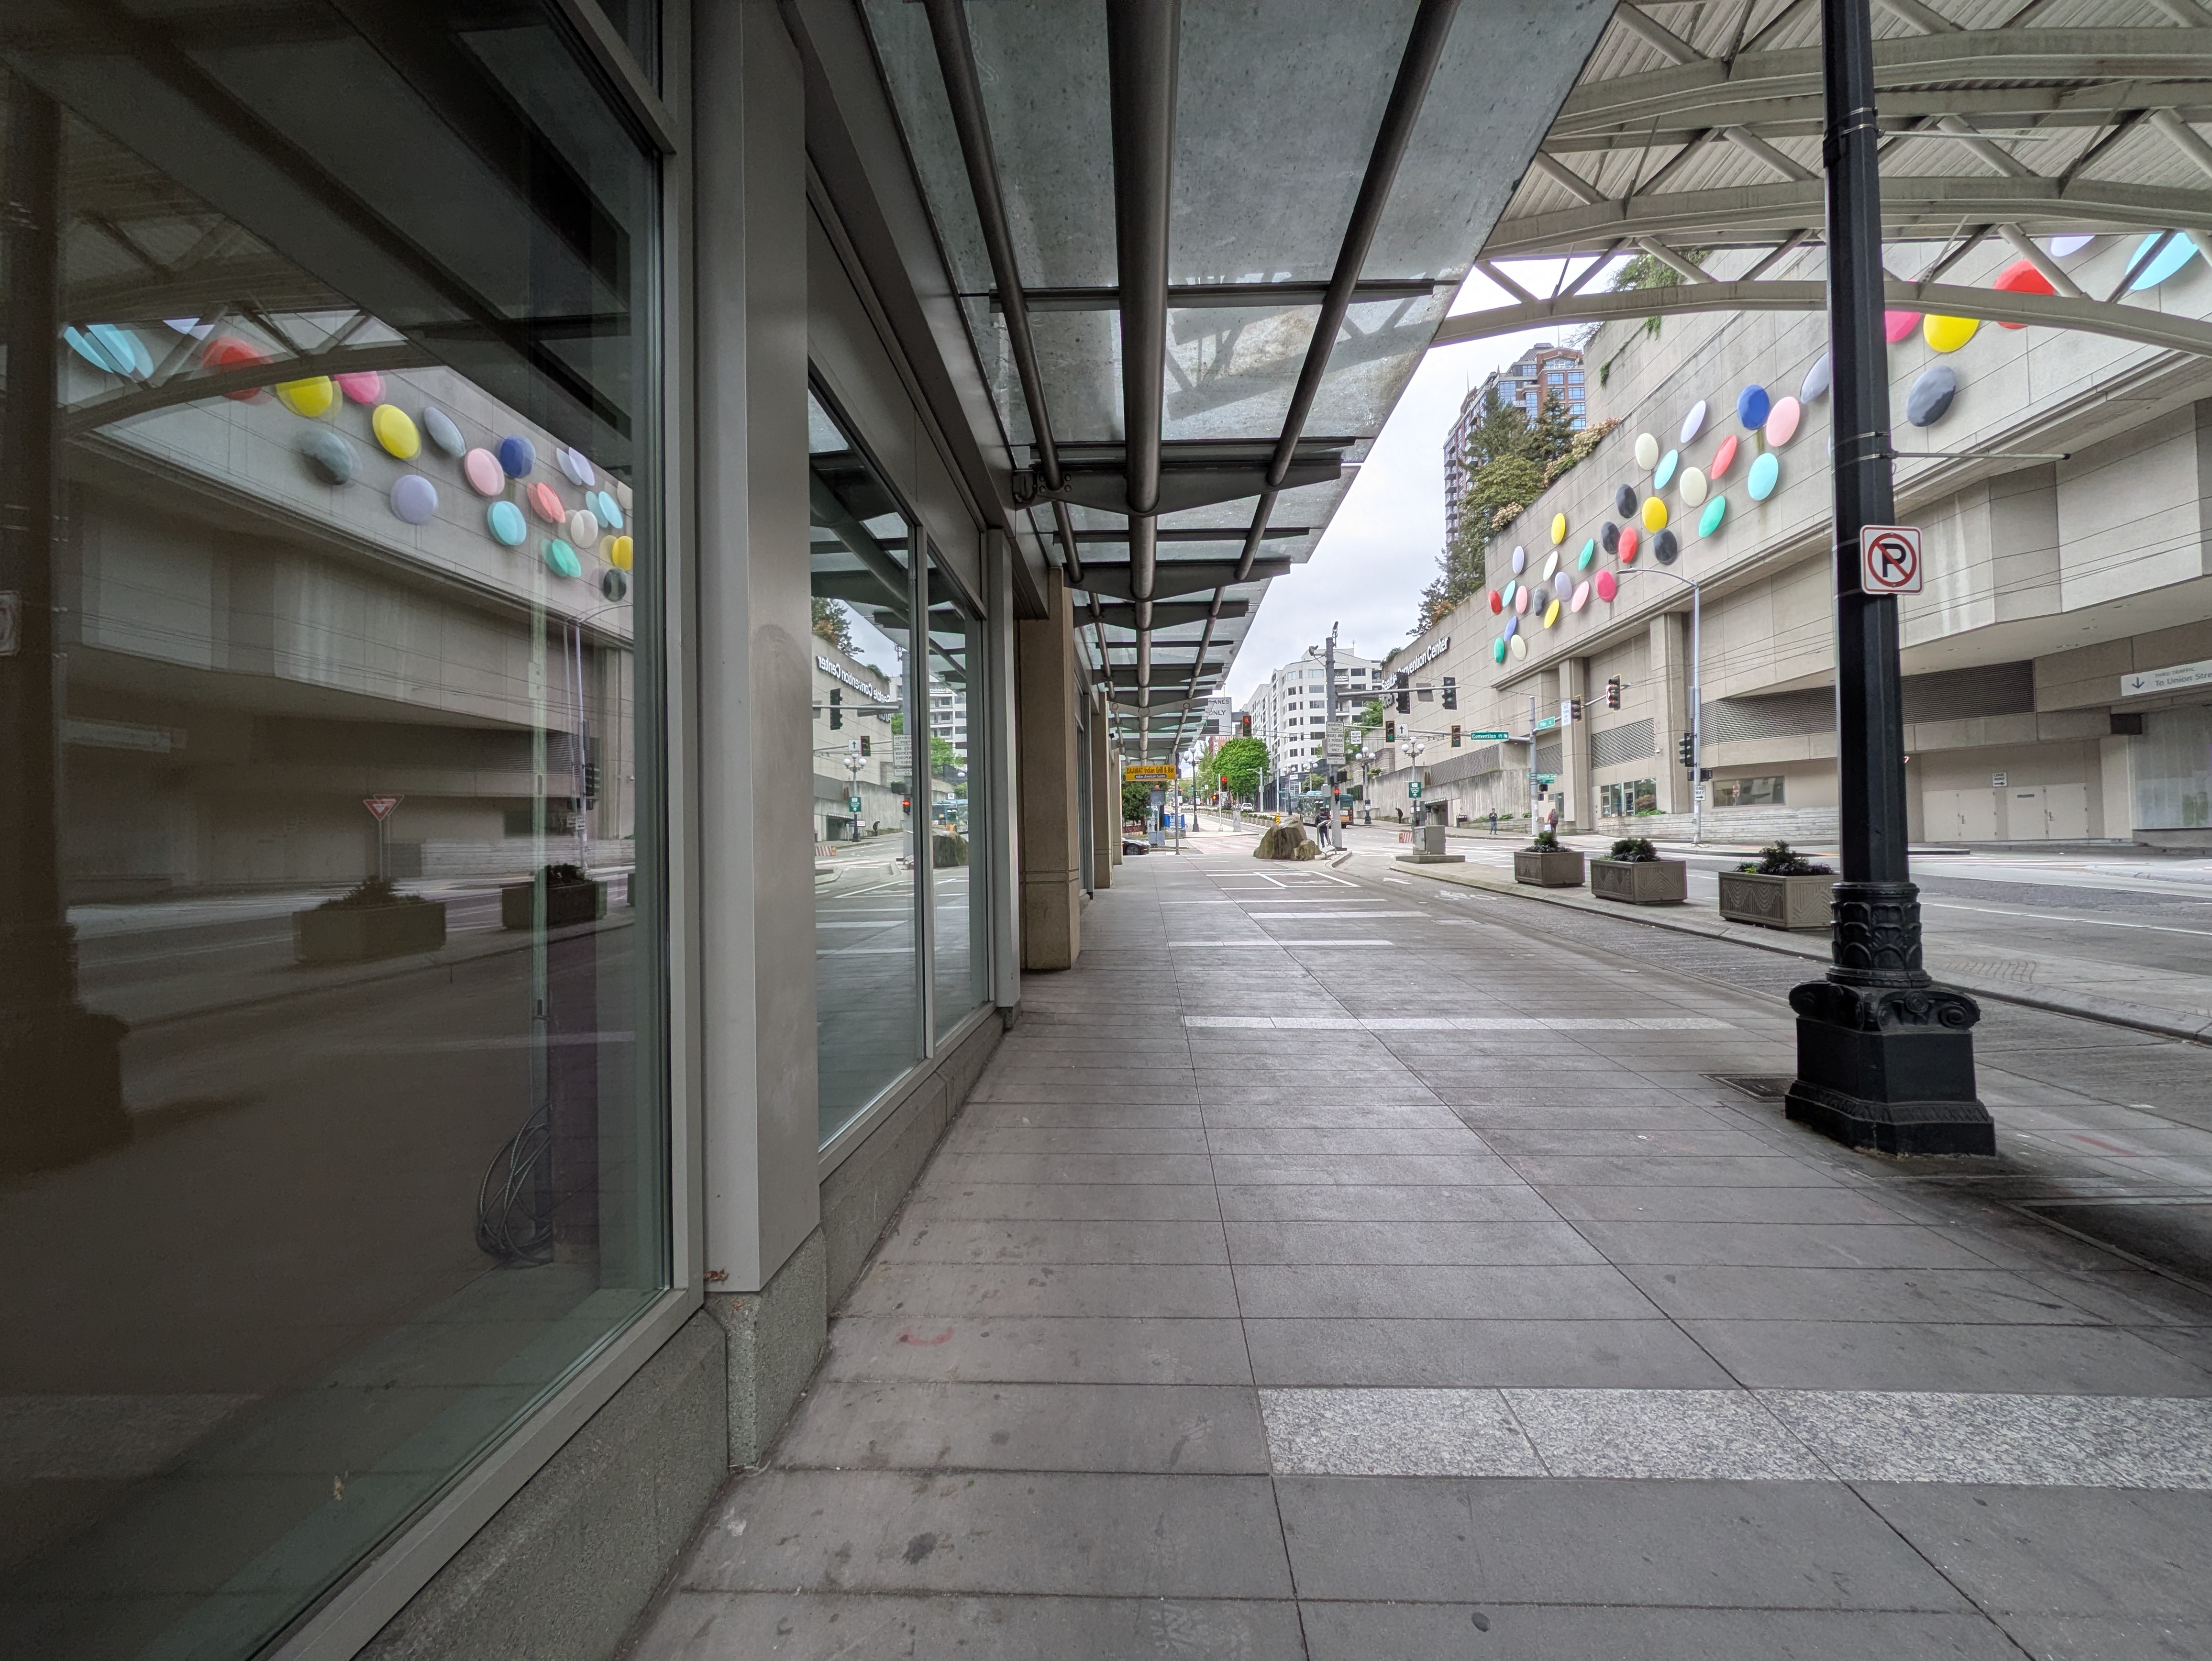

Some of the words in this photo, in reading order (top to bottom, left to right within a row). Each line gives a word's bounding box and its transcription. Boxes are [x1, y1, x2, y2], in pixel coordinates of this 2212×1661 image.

[1382, 673, 1397, 690] Seattle
[1427, 637, 1448, 661] Center
[2167, 675, 2193, 685] Union
